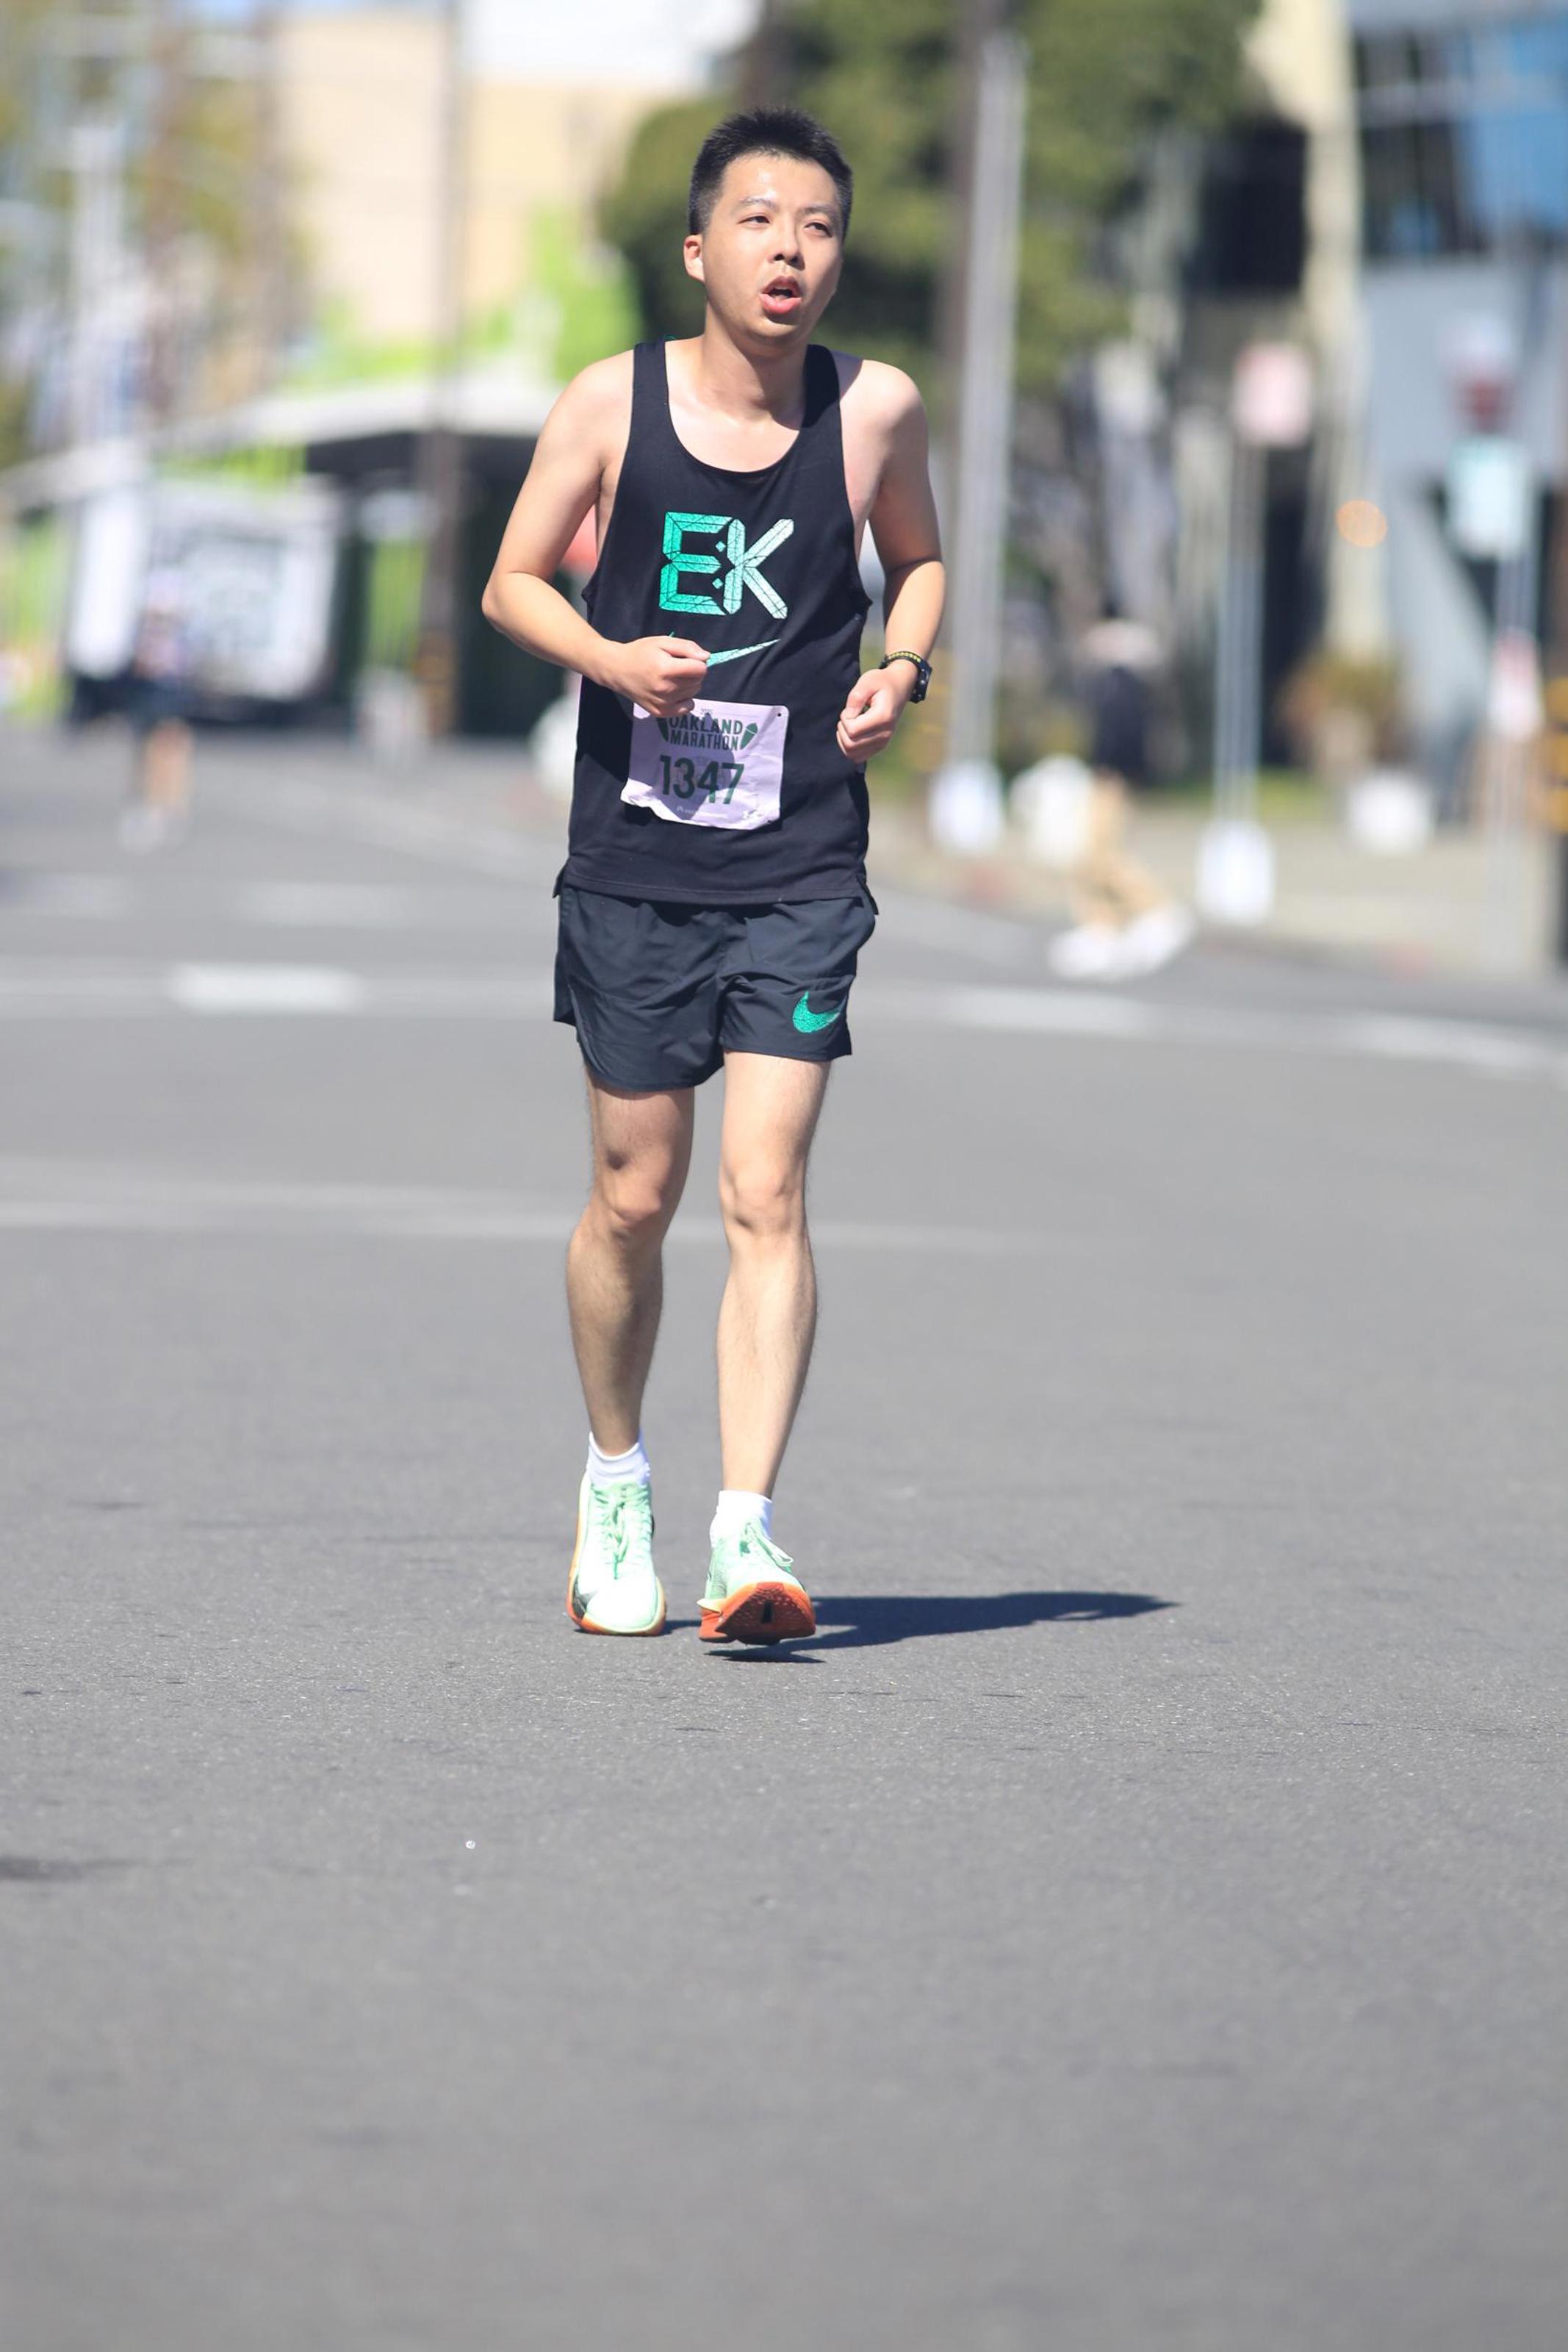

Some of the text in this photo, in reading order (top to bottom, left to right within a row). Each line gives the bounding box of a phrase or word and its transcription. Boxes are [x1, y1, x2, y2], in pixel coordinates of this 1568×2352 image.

[669, 713, 743, 734] OAKLAND
[669, 729, 738, 750] MARATHON
[660, 755, 744, 805] 1347
